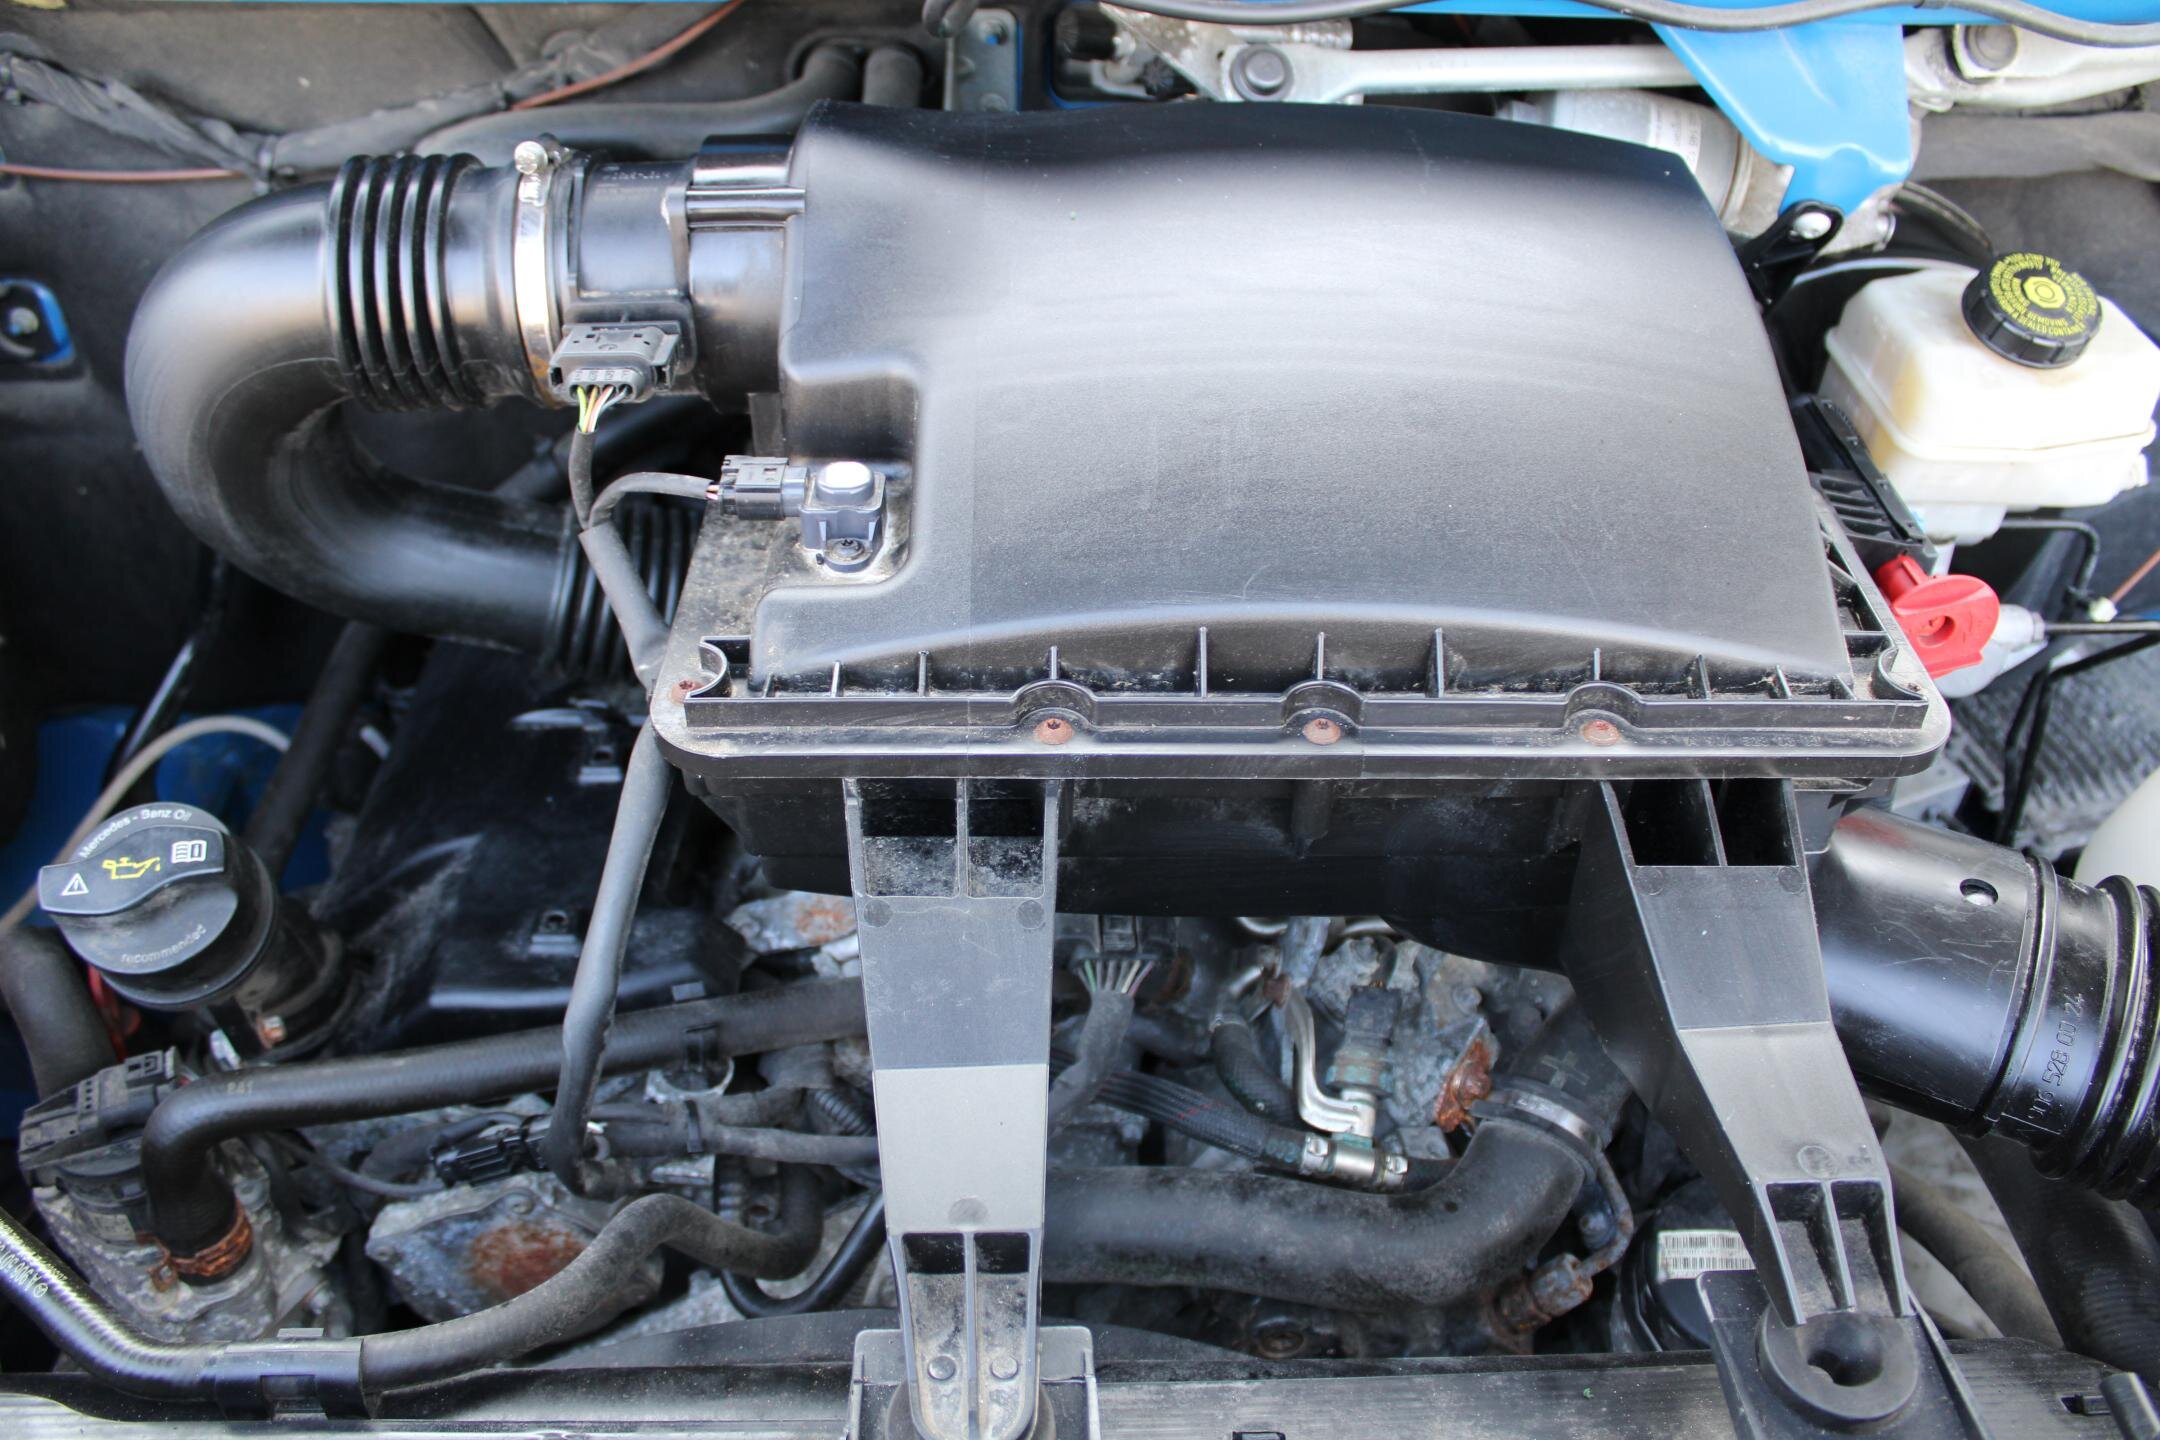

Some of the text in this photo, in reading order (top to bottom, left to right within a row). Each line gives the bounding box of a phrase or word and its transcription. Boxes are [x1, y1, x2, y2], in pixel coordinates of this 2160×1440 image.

[78, 816, 131, 859] Mercedes
[140, 808, 172, 820] Benz
[172, 808, 192, 822] Oil
[121, 923, 207, 963] recommended
[2041, 1049, 2071, 1087] 528
